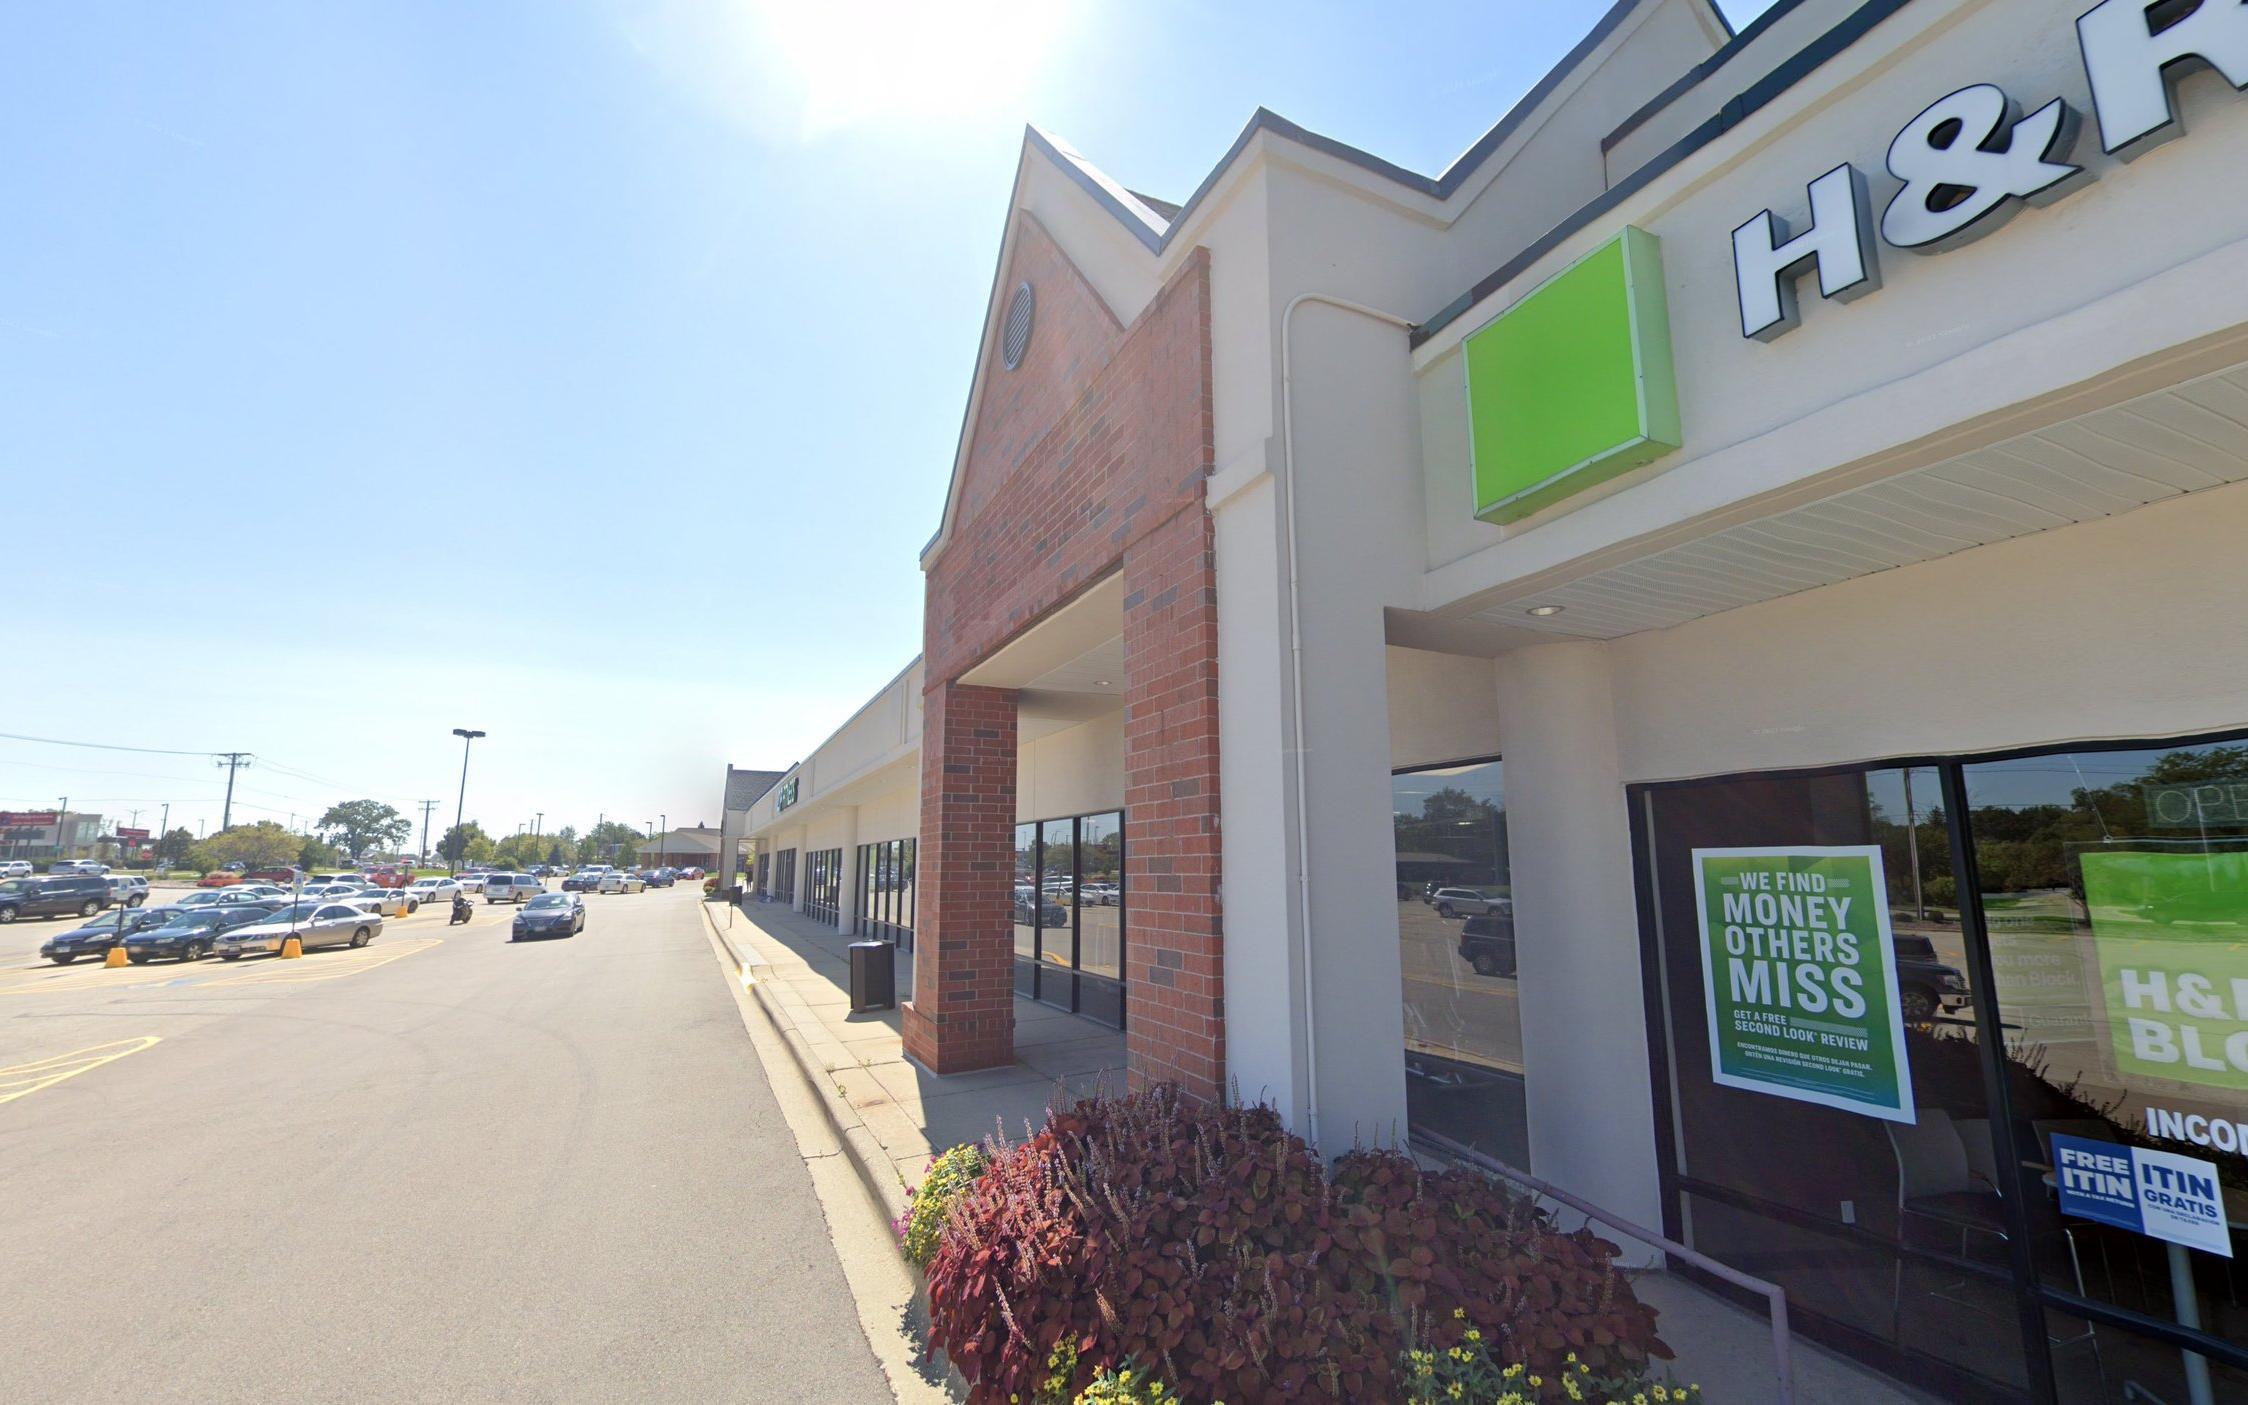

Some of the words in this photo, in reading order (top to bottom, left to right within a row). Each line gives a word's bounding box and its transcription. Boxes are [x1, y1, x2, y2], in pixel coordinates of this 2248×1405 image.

[1739, 871, 1771, 890] WE
[1775, 872, 1826, 893] FIND
[1722, 892, 1852, 930] MONEY
[1724, 924, 1860, 965] OTHERS
[1728, 957, 1867, 1019] MISS
[1734, 1009, 1752, 1021] GET
[1754, 1011, 1761, 1021] A
[1763, 1012, 1788, 1025] FREE
[1734, 1020, 1781, 1036] SECOND
[1821, 1033, 1869, 1051] REVIEW
[2060, 1147, 2131, 1175] FREE
[2061, 1166, 2134, 1200] ITIN
[2141, 1163, 2215, 1201] ITIN
[2144, 1188, 2218, 1218] GRATIS
